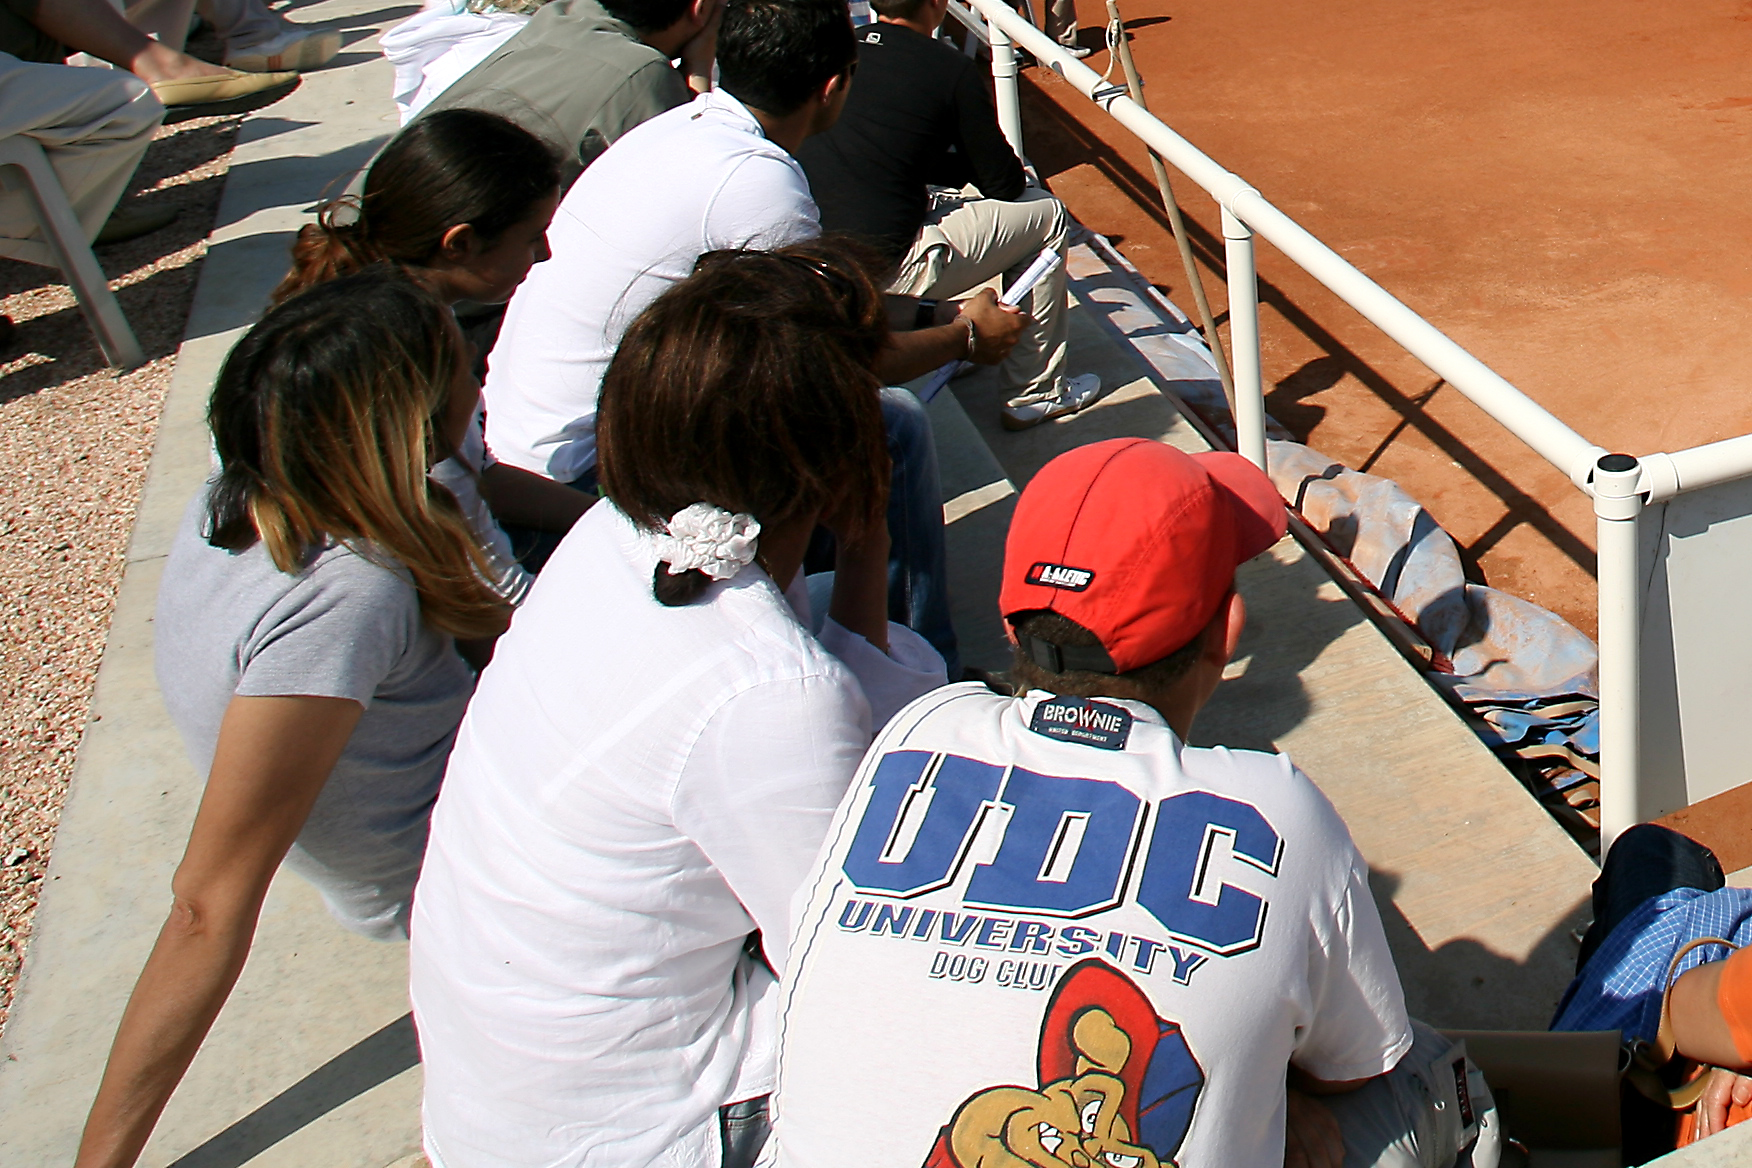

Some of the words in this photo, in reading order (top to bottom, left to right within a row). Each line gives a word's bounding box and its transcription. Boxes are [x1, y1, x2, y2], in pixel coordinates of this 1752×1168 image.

[1043, 704, 1123, 733] BROWNIE
[840, 748, 1286, 958] UDC
[835, 899, 1210, 987] UNIVERSITY
[927, 950, 990, 984] DOG
